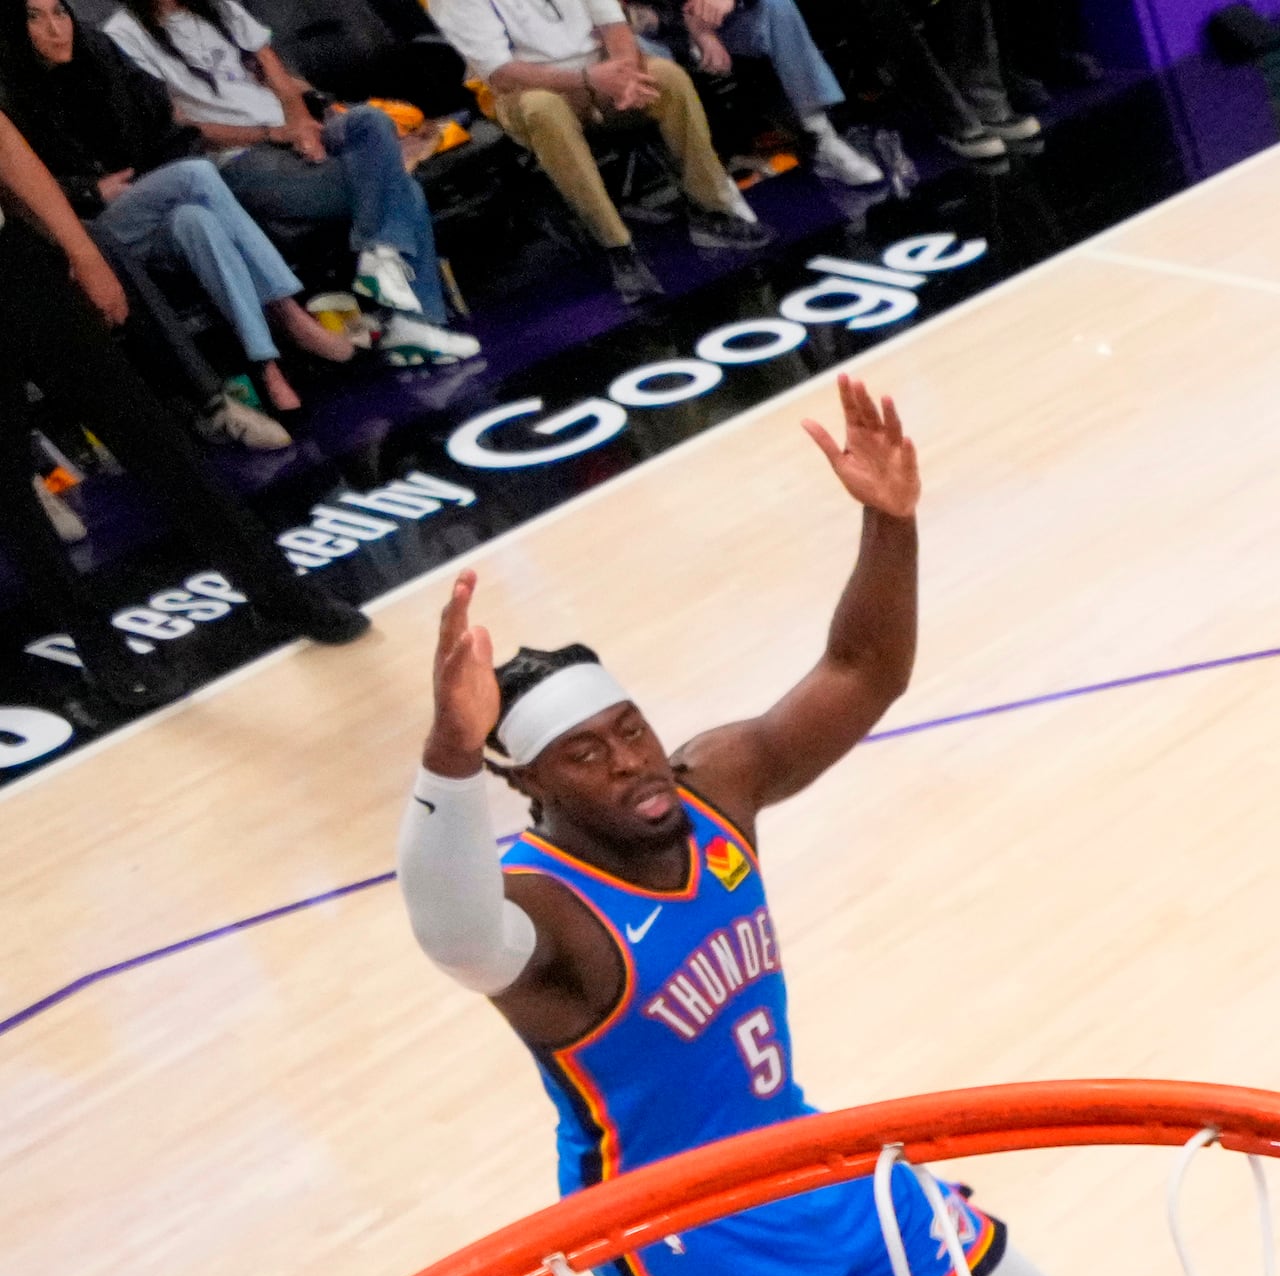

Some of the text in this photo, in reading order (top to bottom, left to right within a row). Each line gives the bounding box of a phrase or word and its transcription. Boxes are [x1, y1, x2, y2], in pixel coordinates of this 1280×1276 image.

[338, 470, 476, 520] by
[446, 232, 988, 470] Google
[646, 909, 783, 1039] THUNDE
[735, 1009, 784, 1097] 5
